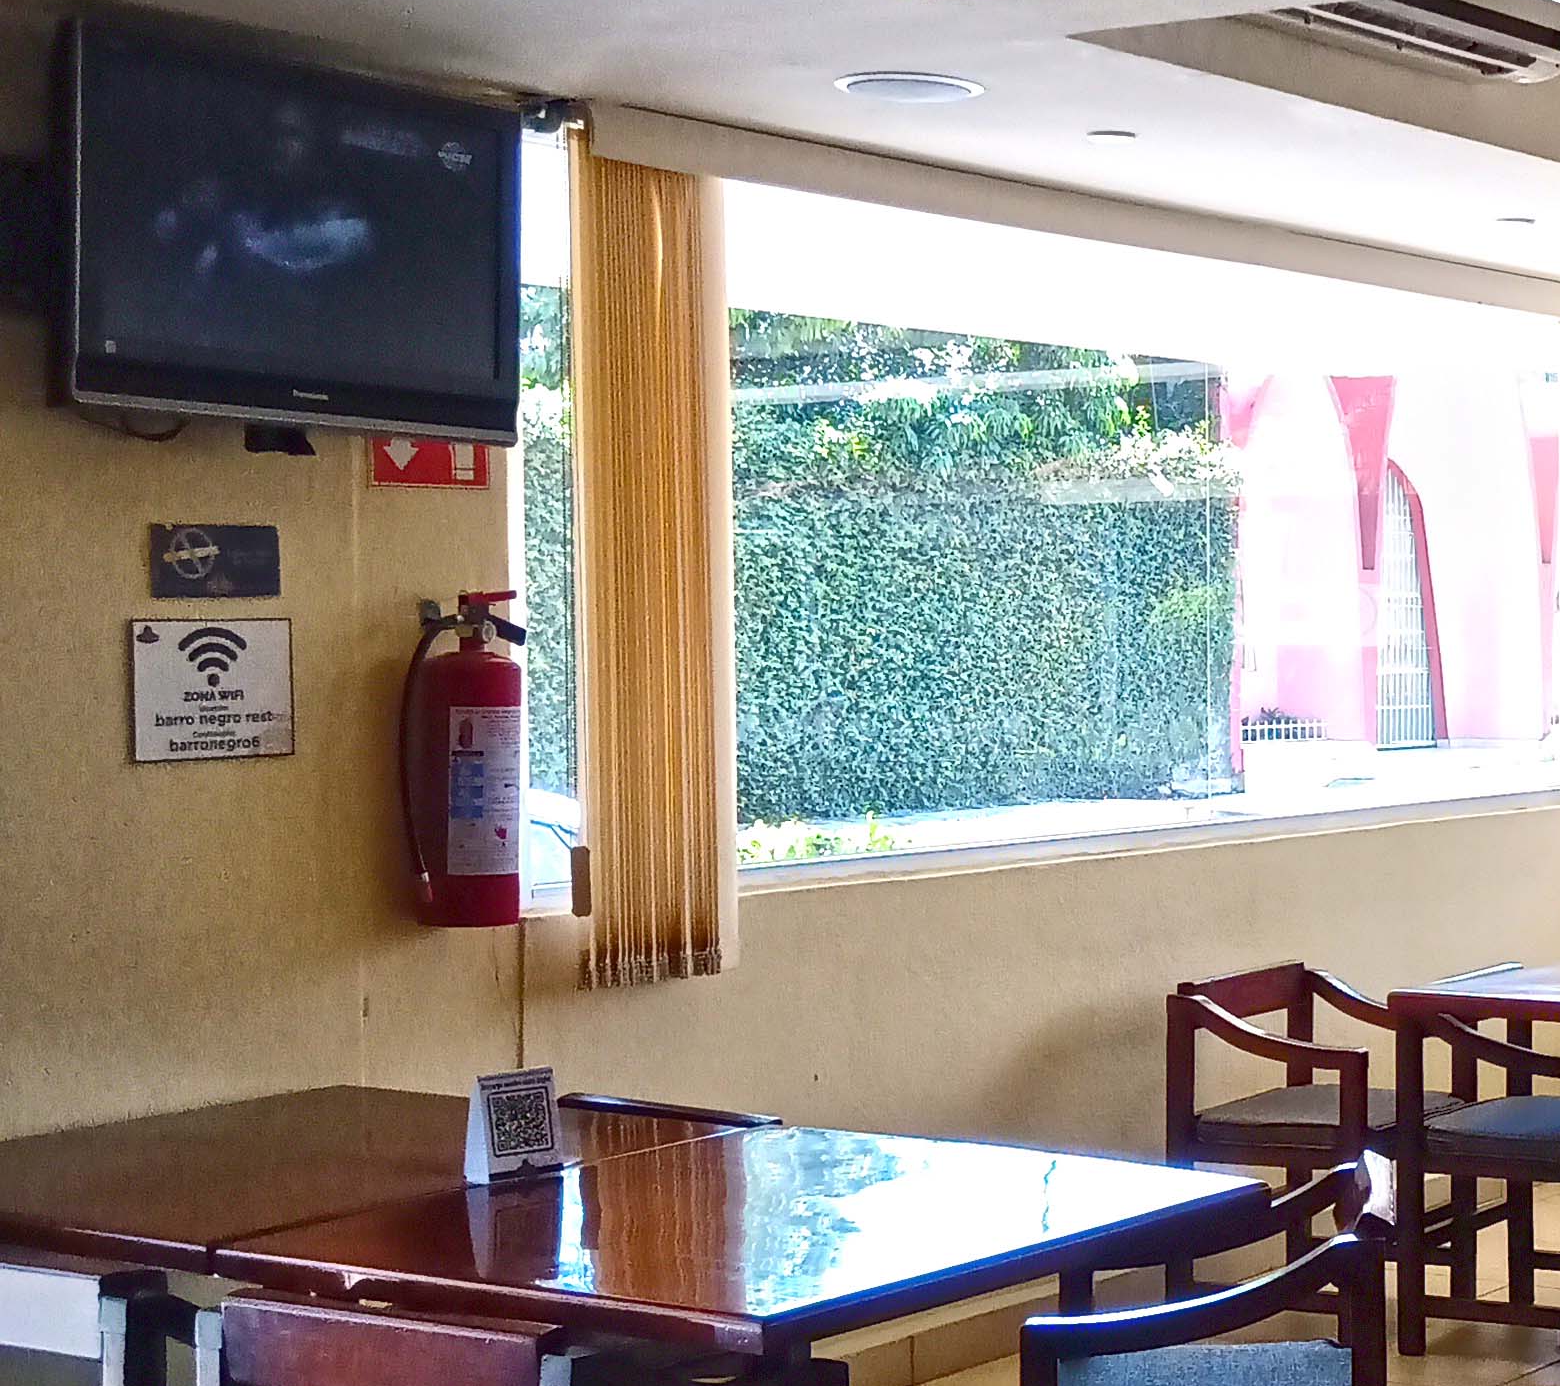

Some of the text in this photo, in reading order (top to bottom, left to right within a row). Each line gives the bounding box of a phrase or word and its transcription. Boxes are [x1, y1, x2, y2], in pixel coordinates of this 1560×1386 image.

[183, 689, 245, 702] ZONA WIFI
[154, 714, 195, 727] barro
[199, 713, 242, 727] negro
[169, 736, 260, 752] barronegro6
